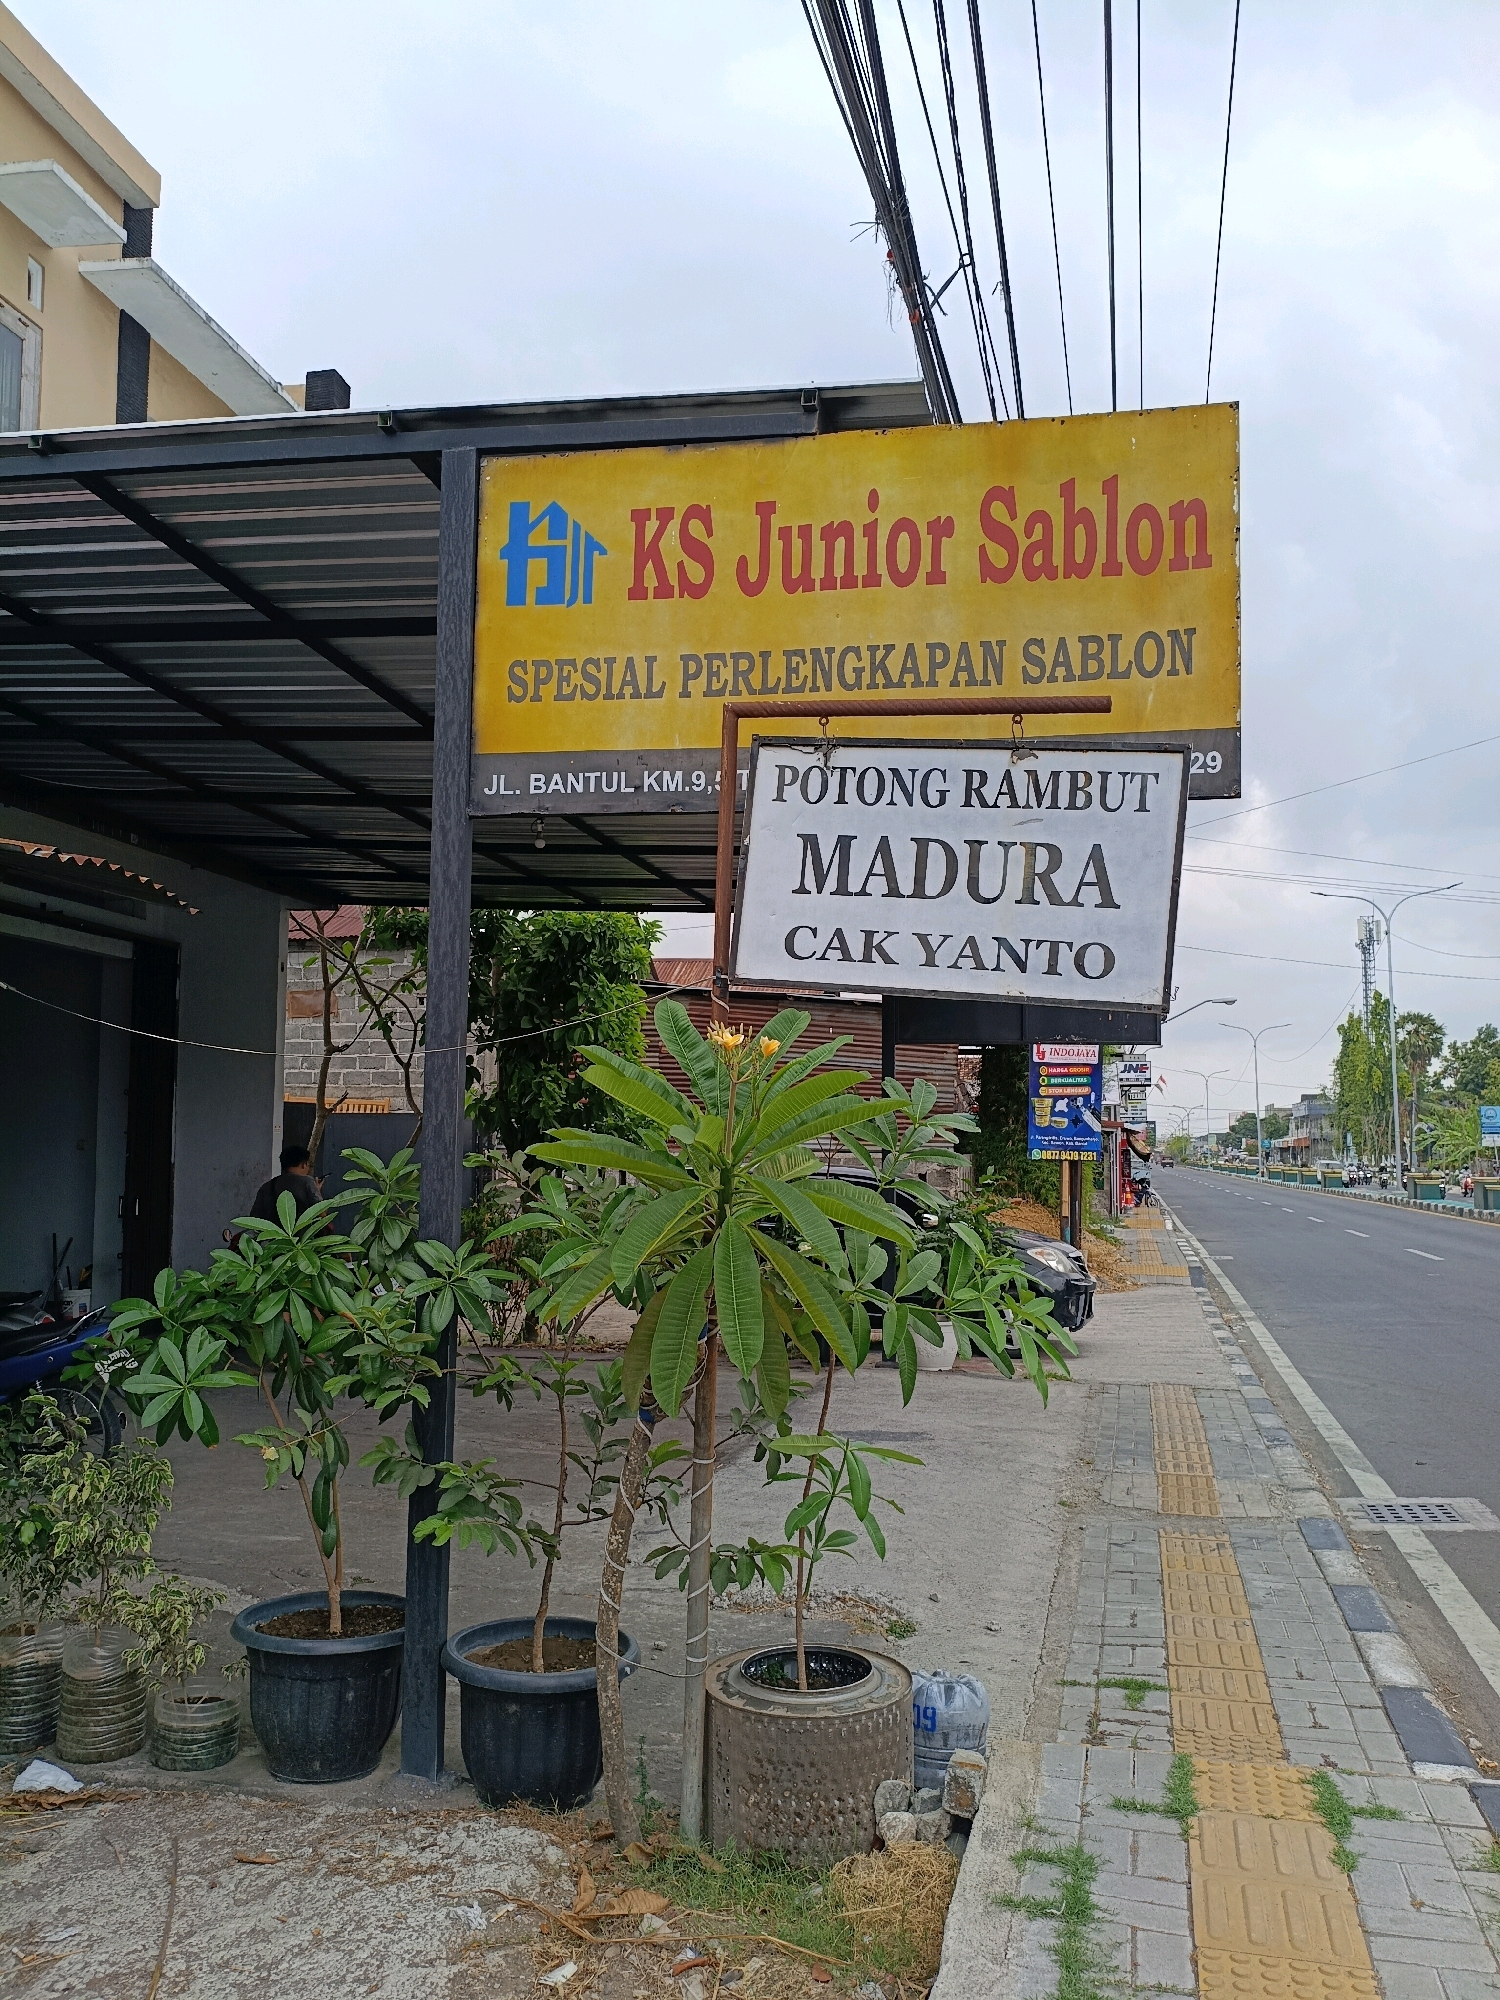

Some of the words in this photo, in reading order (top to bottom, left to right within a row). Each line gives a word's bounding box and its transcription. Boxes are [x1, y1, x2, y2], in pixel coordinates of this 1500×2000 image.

[627, 503, 715, 601] KS
[735, 487, 956, 598] Junior
[978, 474, 1213, 585] Sablon
[507, 656, 665, 703] SPESIAL
[679, 640, 1006, 698] PERLENGKAPAN
[1022, 628, 1197, 684] SABLON
[483, 774, 521, 795] JL.
[529, 771, 635, 795] BANTUL
[771, 764, 951, 809] POTONG
[960, 768, 1160, 813] RAMBUT
[791, 833, 1122, 910] MADURA
[784, 925, 900, 966] CAK
[912, 932, 1117, 980] YANTO
[1049, 1047, 1097, 1058] INDOJAYA
[1120, 1063, 1149, 1074] JNE
[1041, 1150, 1059, 1160] 0877
[1080, 1151, 1097, 1161] 7231
